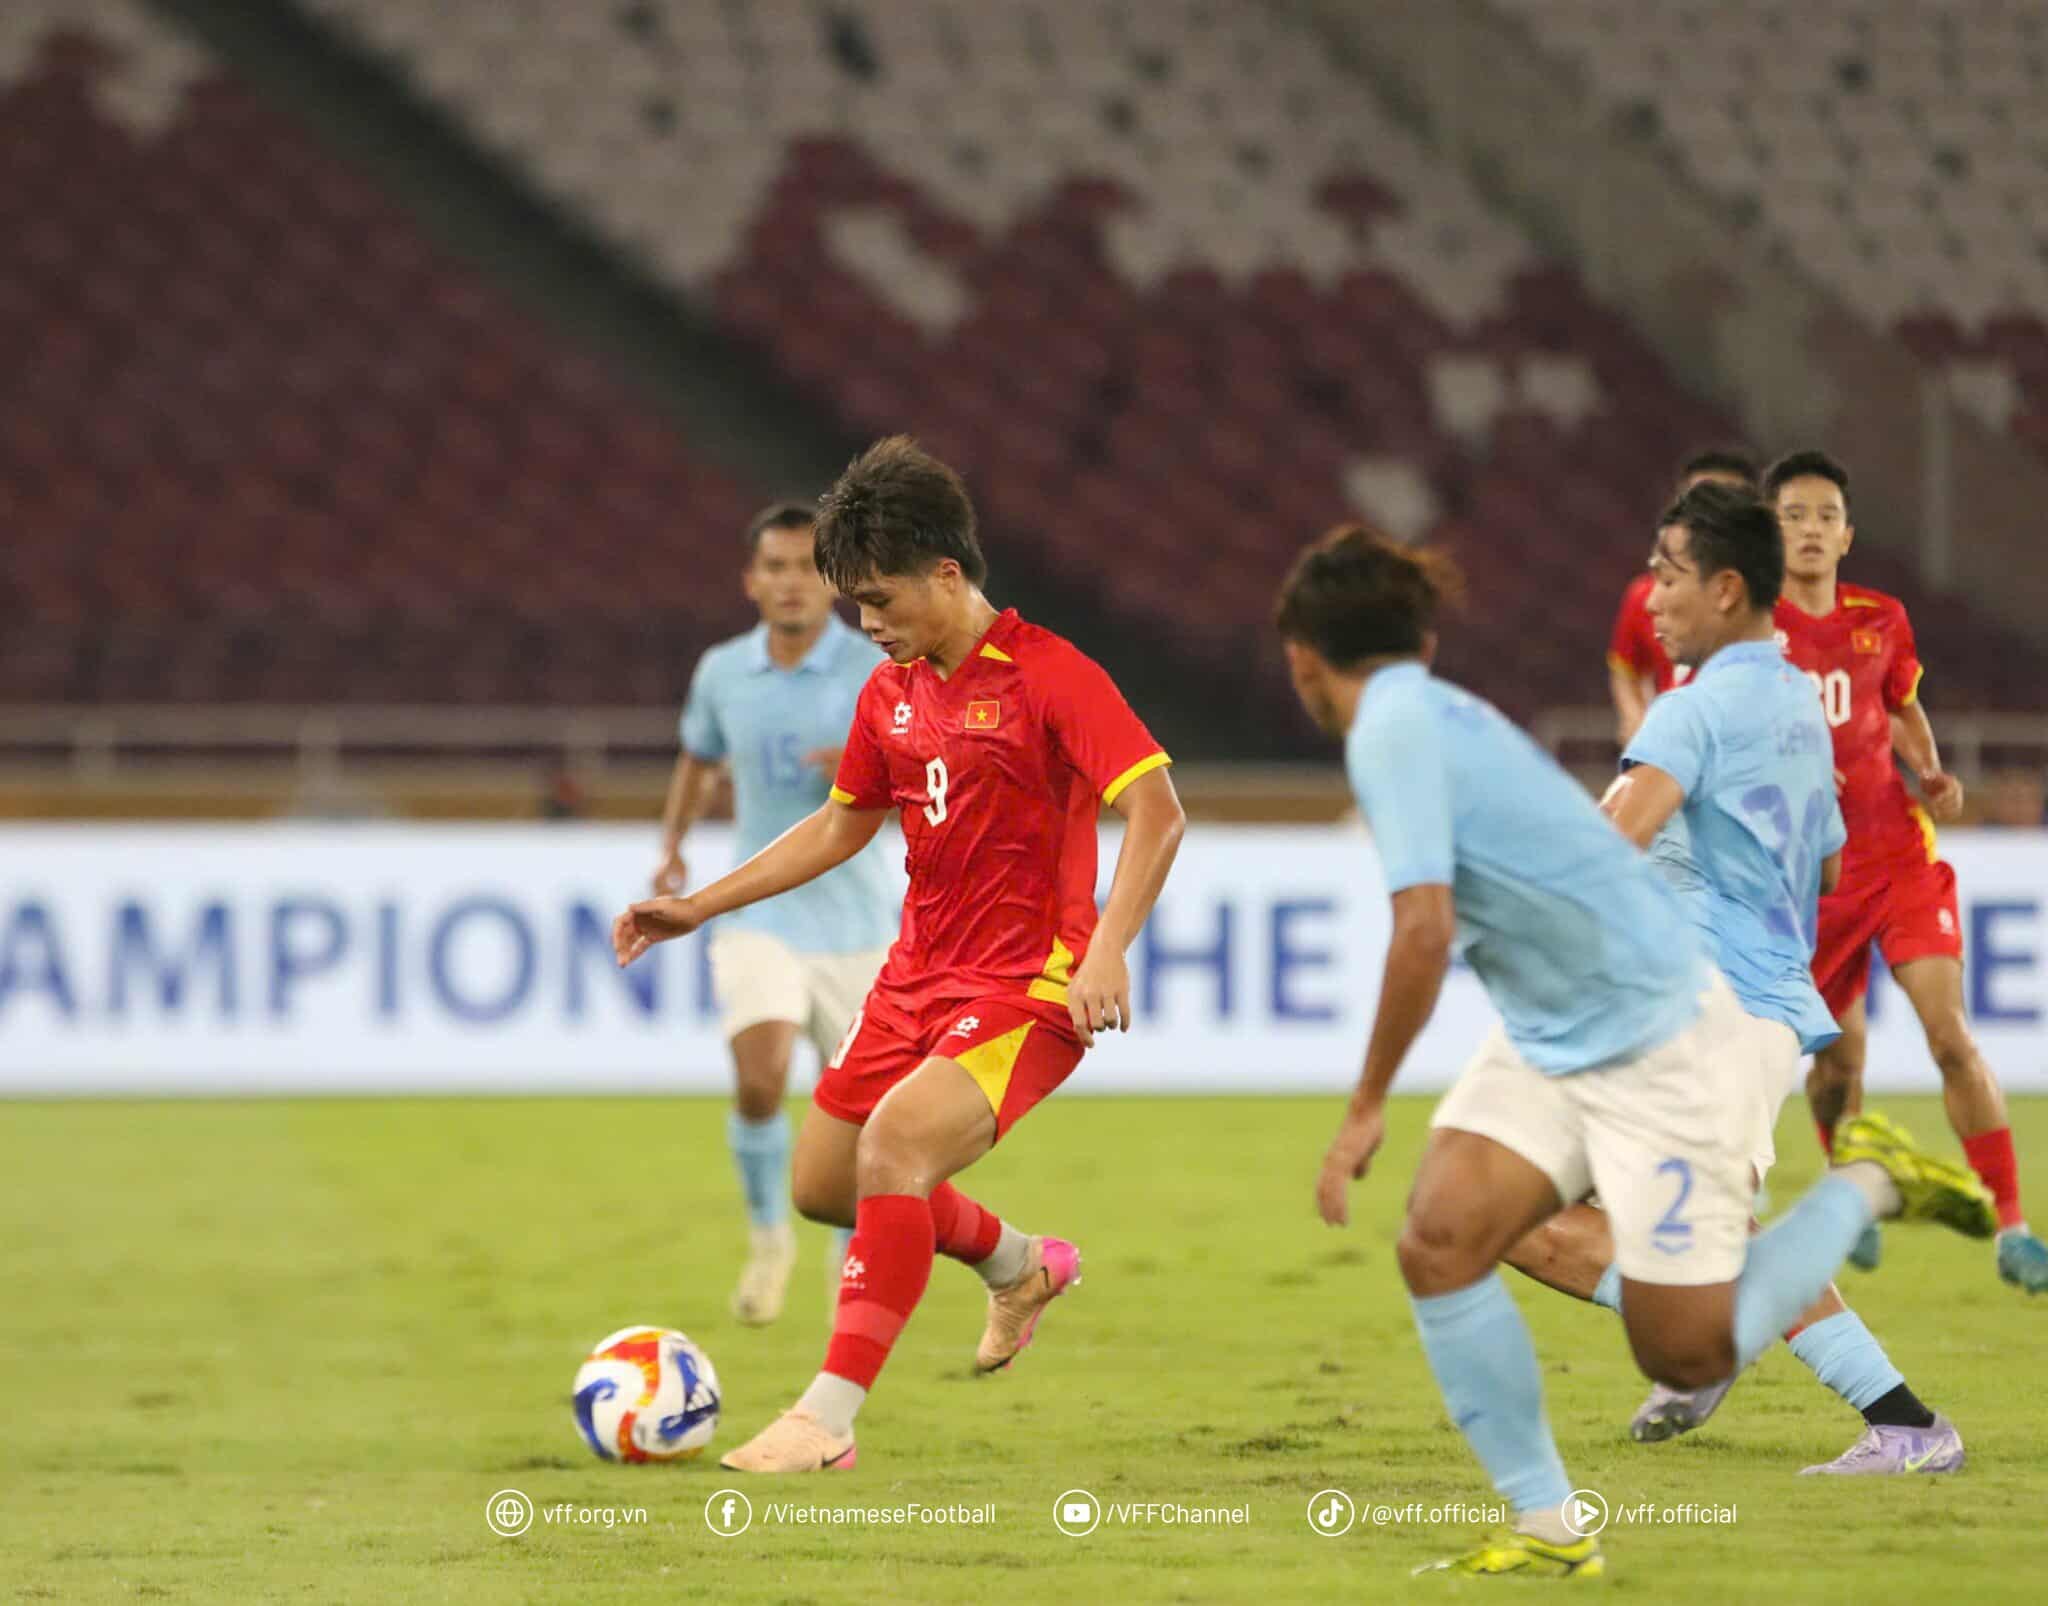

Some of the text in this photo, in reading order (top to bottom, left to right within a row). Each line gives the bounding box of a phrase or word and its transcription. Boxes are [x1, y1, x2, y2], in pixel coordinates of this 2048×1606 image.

[923, 756, 948, 827] 9
[0, 899, 719, 1017] AMPION
[1097, 899, 1336, 1019] HE
[1653, 1156, 1693, 1234] 2
